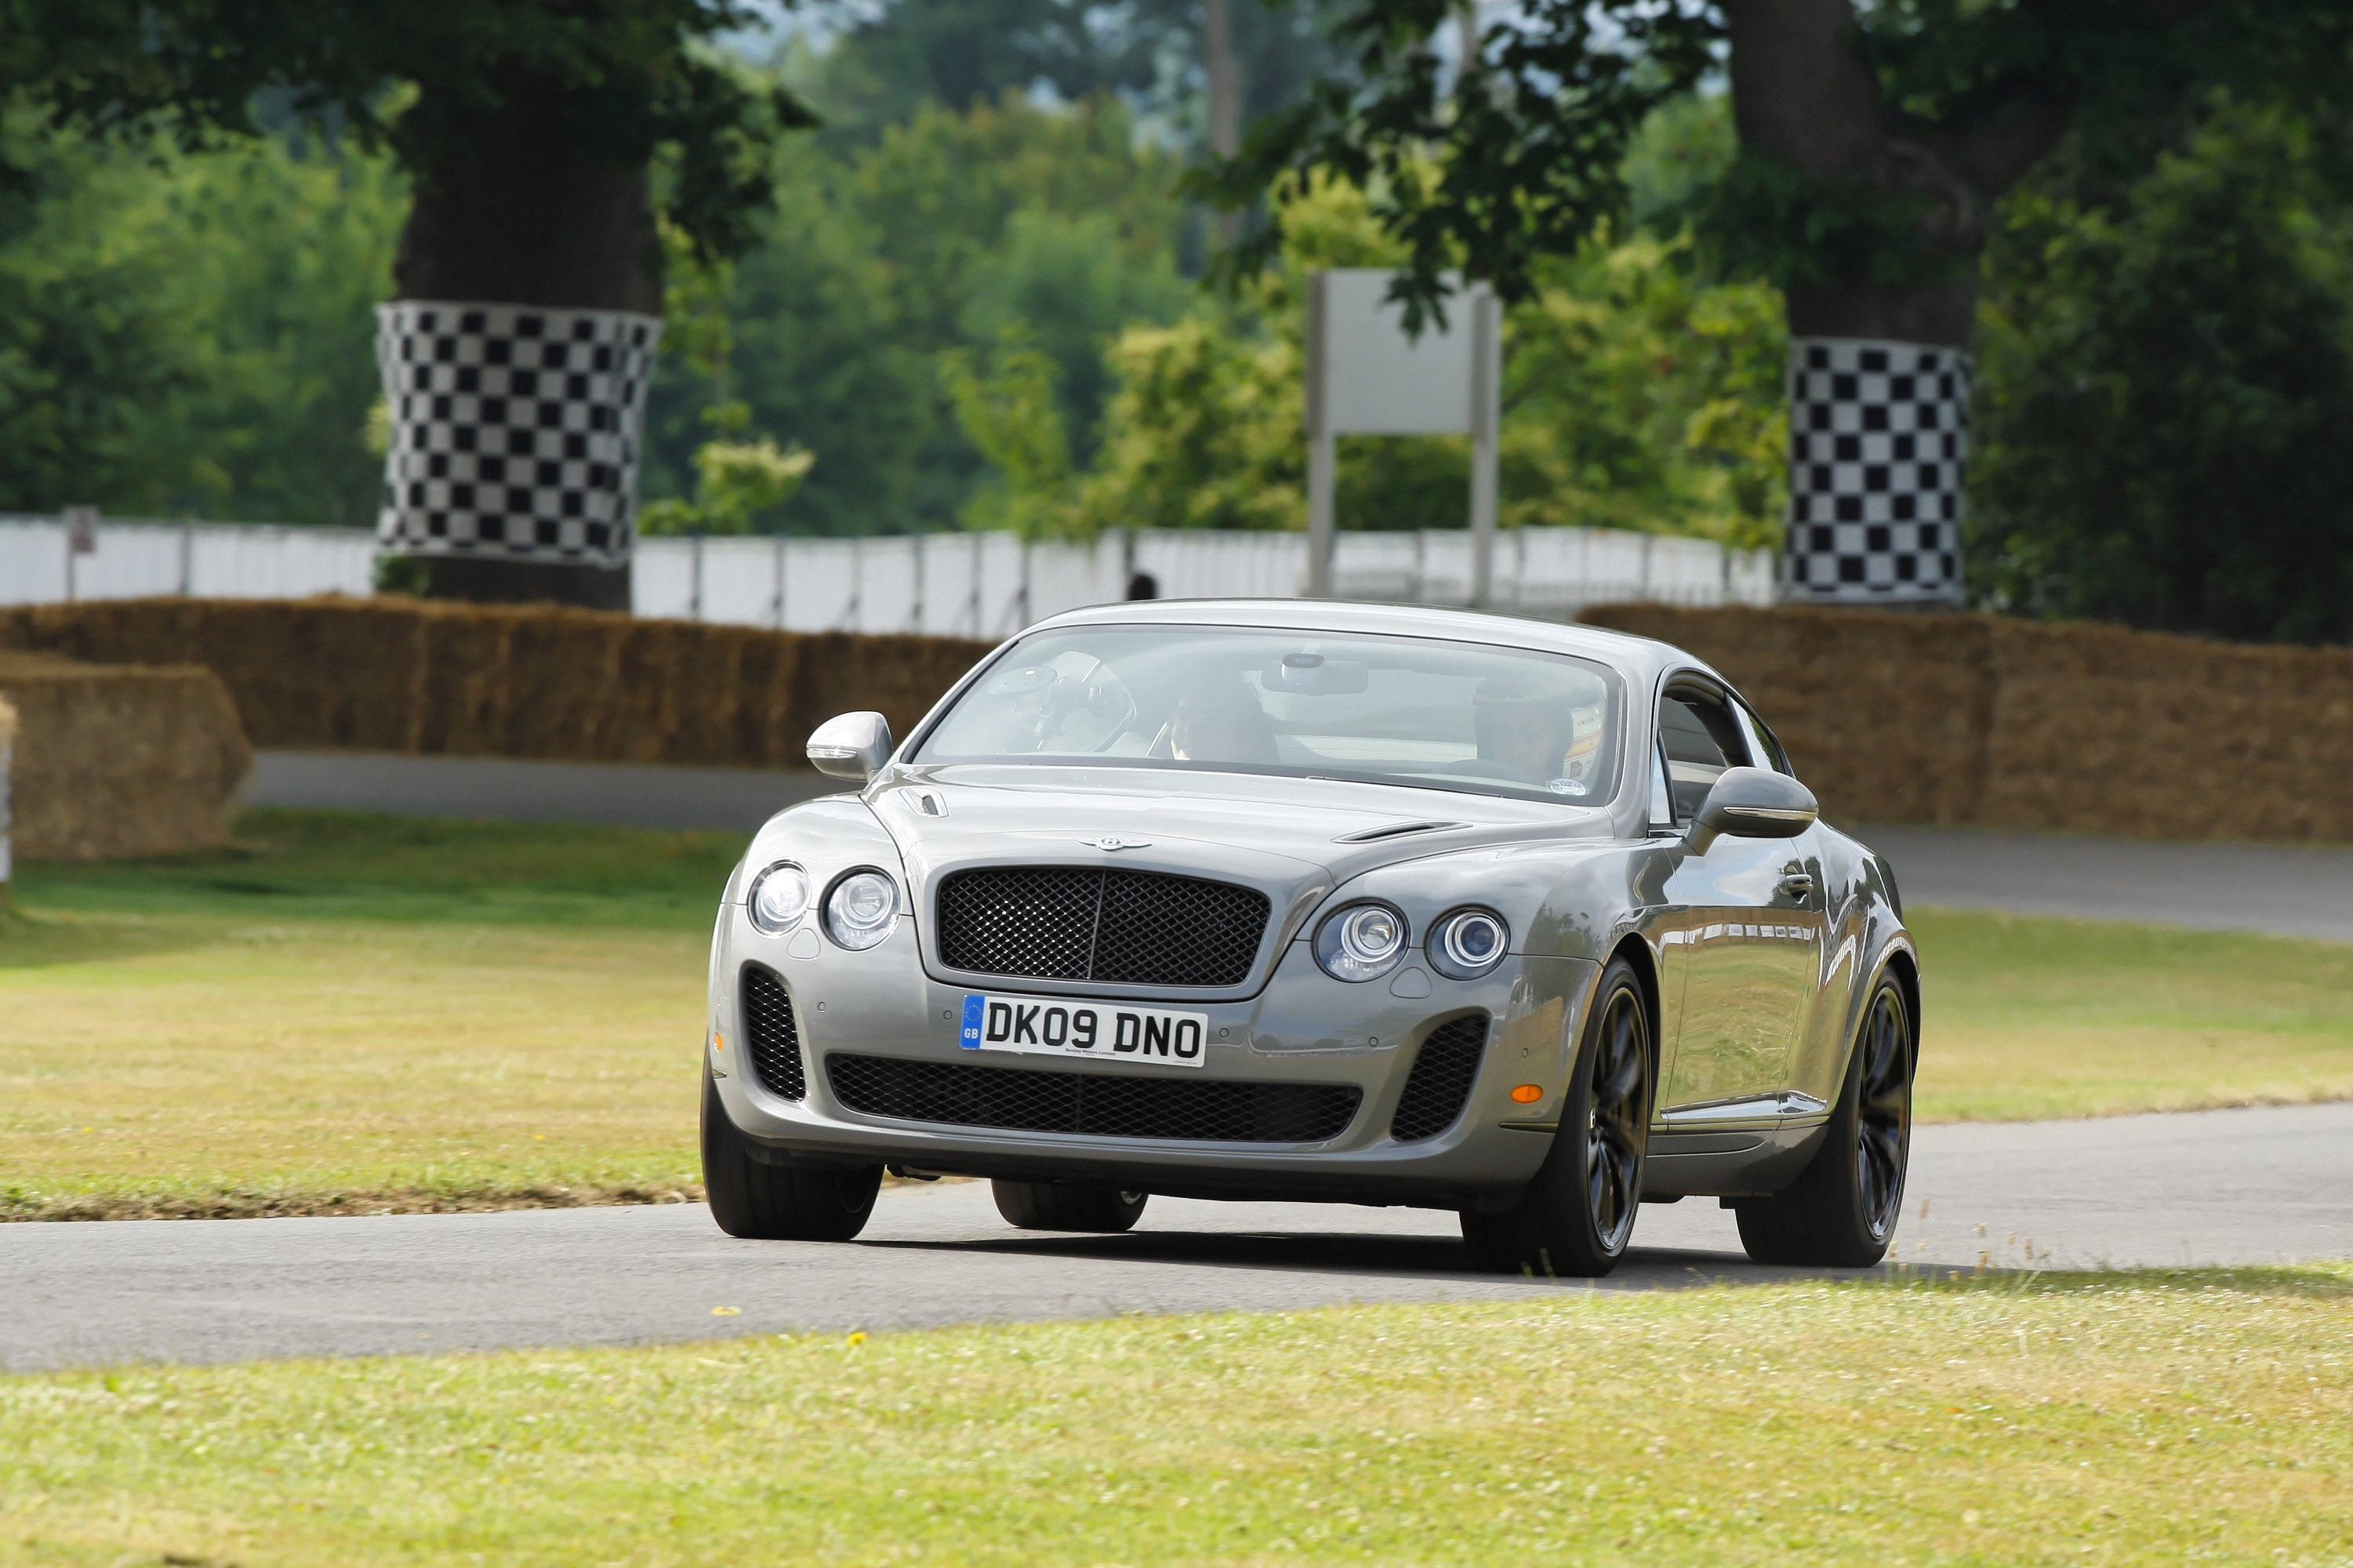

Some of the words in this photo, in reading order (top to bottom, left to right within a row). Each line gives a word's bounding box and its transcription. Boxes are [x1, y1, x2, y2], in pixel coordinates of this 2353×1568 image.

[964, 1028, 979, 1040] GB
[986, 1003, 1098, 1048] DK09
[1113, 1012, 1200, 1058] DNO
